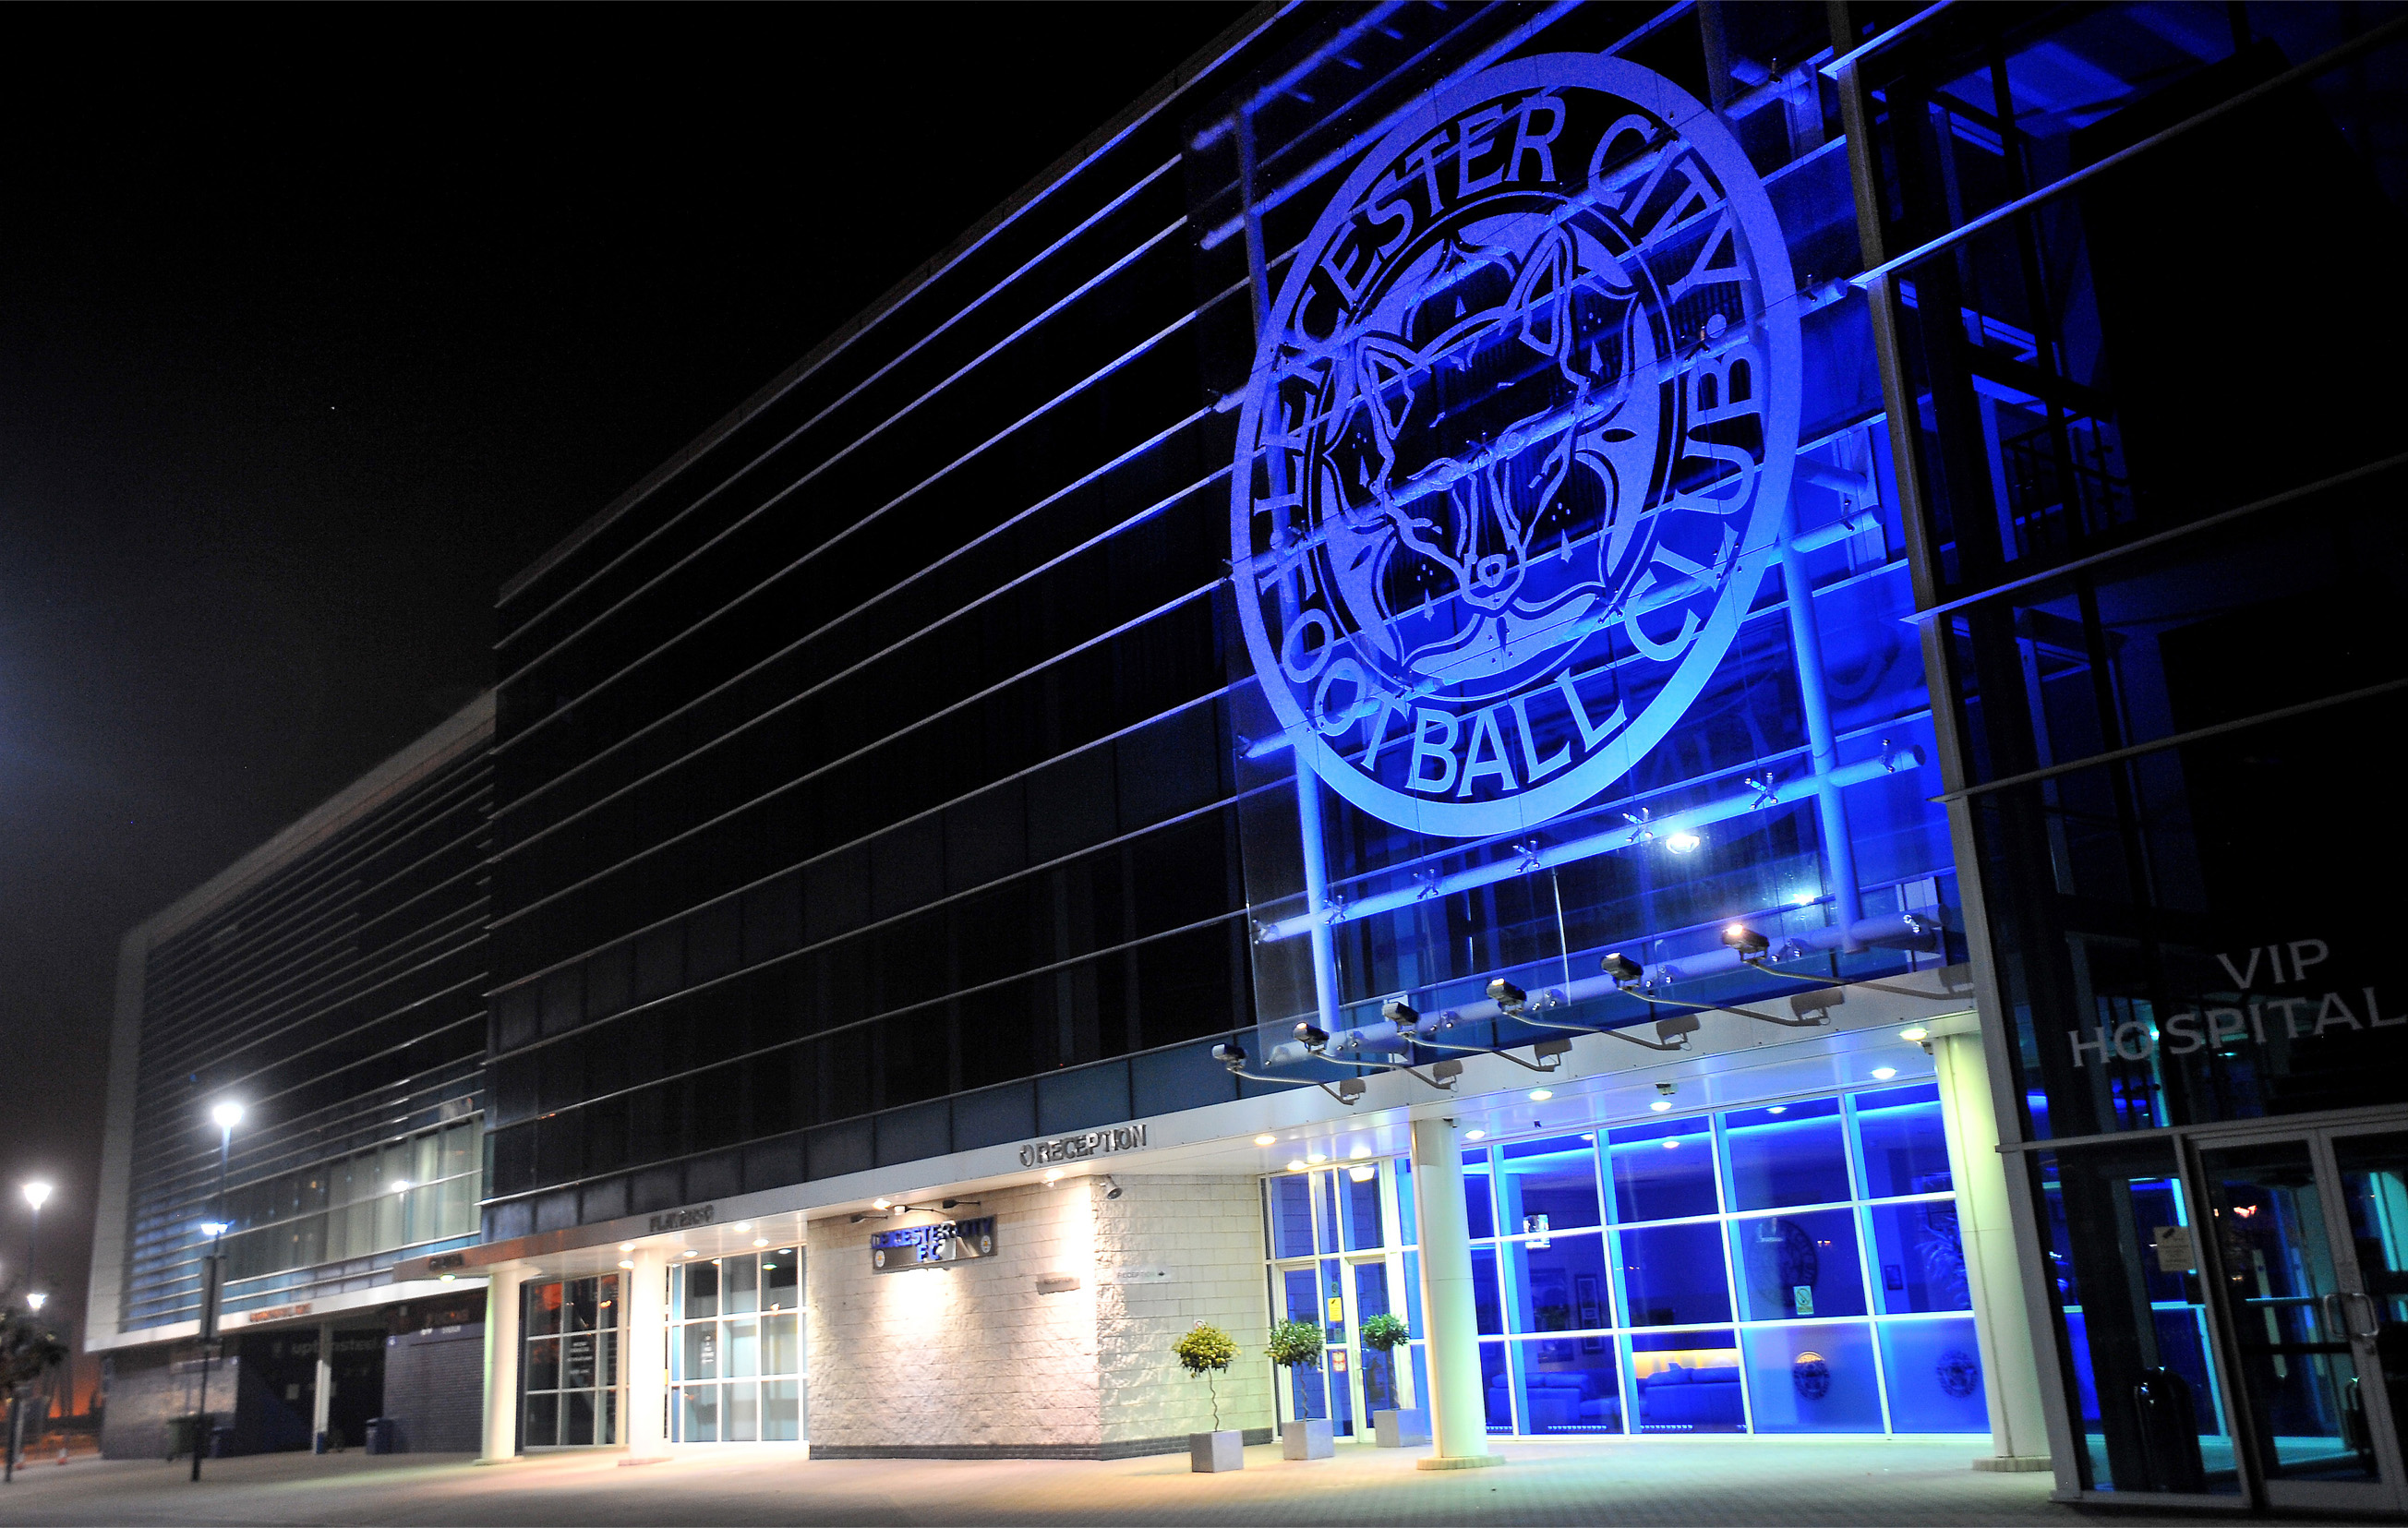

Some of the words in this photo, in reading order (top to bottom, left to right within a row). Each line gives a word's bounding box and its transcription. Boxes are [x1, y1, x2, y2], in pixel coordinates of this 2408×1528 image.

[1587, 114, 1752, 304] CITY
[1258, 547, 1625, 798] FOOTBALL
[1624, 343, 1765, 663] CLUB
[2217, 938, 2330, 990] VIP
[2067, 986, 2407, 1067] HOSPITAL
[1036, 1125, 1147, 1163] RECEPTION
